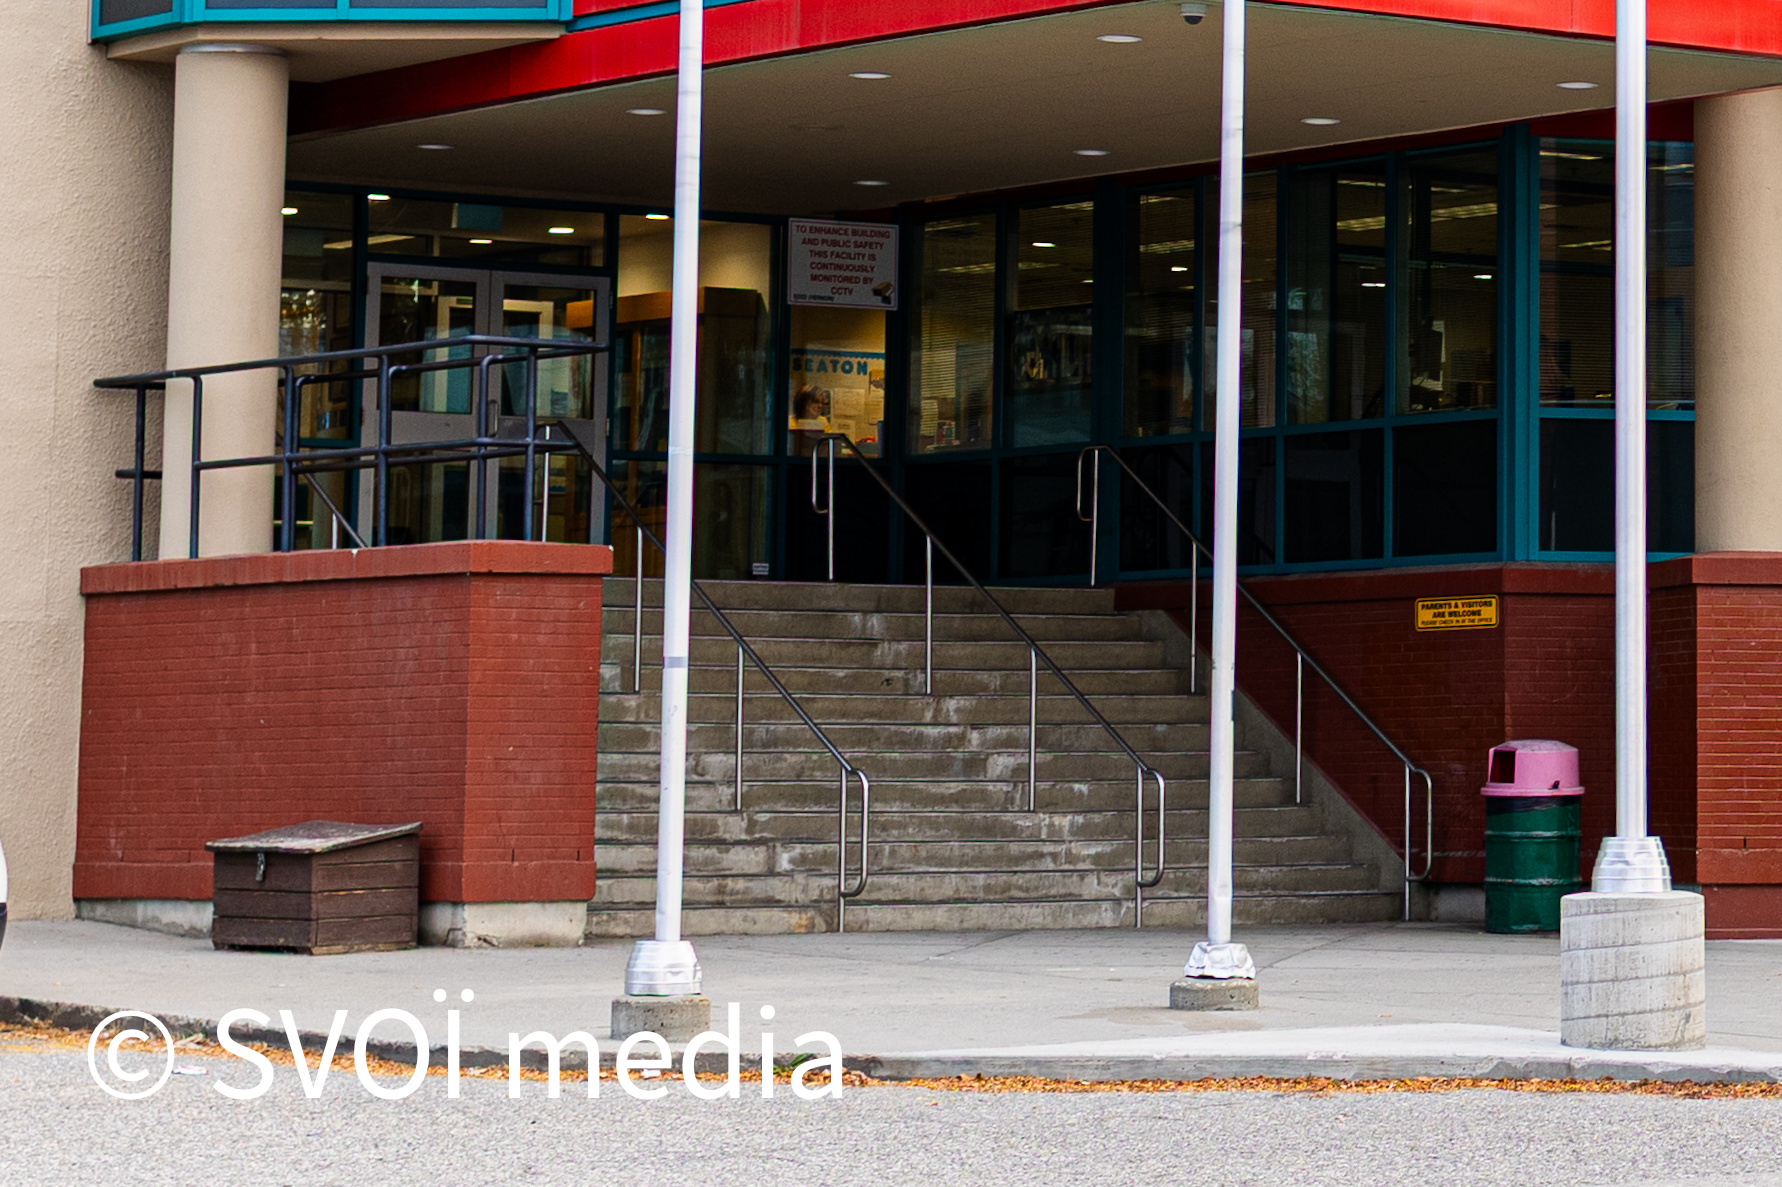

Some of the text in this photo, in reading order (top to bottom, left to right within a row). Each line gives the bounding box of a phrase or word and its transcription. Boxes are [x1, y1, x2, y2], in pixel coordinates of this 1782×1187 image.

[795, 224, 890, 239] TO ENHANCE BUILDING
[801, 237, 884, 250] AND PUBLIC SAFETY
[809, 249, 876, 261] THIS FACILITY IS
[809, 261, 875, 273] CONTINUOUSLY
[810, 273, 874, 285] MONITORED BY
[830, 286, 854, 295] CCTV
[792, 357, 868, 375] SEATON
[1421, 602, 1452, 610] PARENTS
[1461, 600, 1493, 608] VISITORS
[1448, 610, 1482, 618] WELCOME
